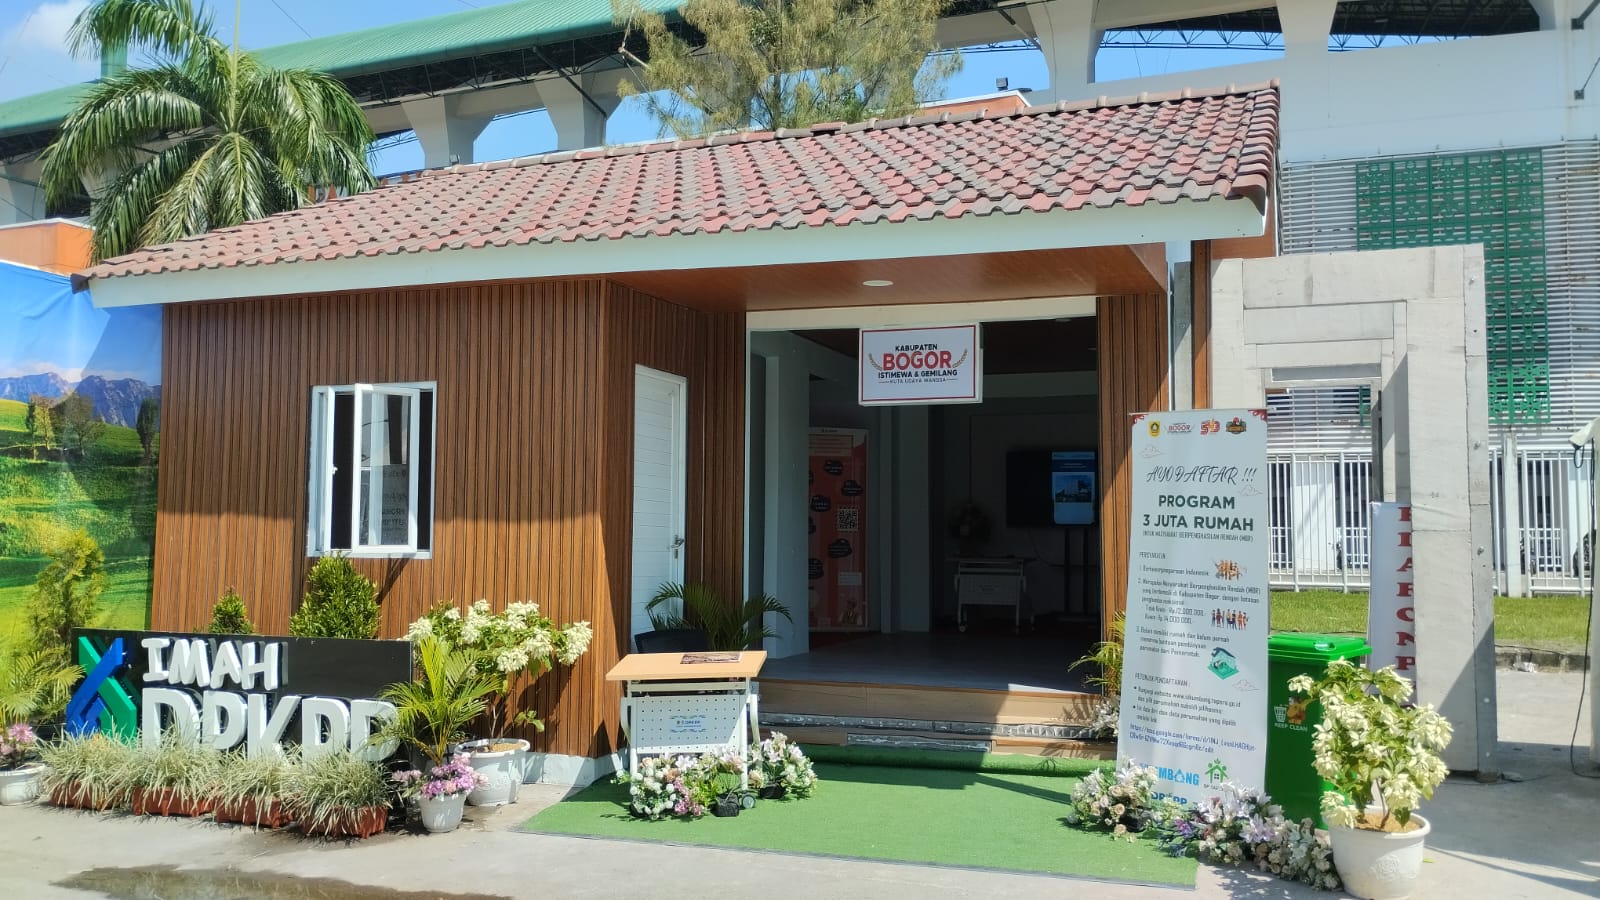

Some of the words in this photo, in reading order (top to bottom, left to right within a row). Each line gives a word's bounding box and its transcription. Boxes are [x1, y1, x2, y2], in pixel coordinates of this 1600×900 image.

[895, 344, 938, 352] KABUPATEN
[882, 350, 952, 371] BOGOR
[878, 371, 913, 379] ISTIMEWA
[920, 369, 958, 377] GEMILANG
[1146, 466, 1173, 483] AYO
[1174, 466, 1238, 485] DAFTAR
[1241, 468, 1257, 482] !!!
[1158, 494, 1235, 509] PROGRAM
[1142, 514, 1150, 526] 3
[1154, 514, 1188, 528] JUTA
[1193, 516, 1254, 531] RUMAH
[142, 638, 279, 691] IMAH
